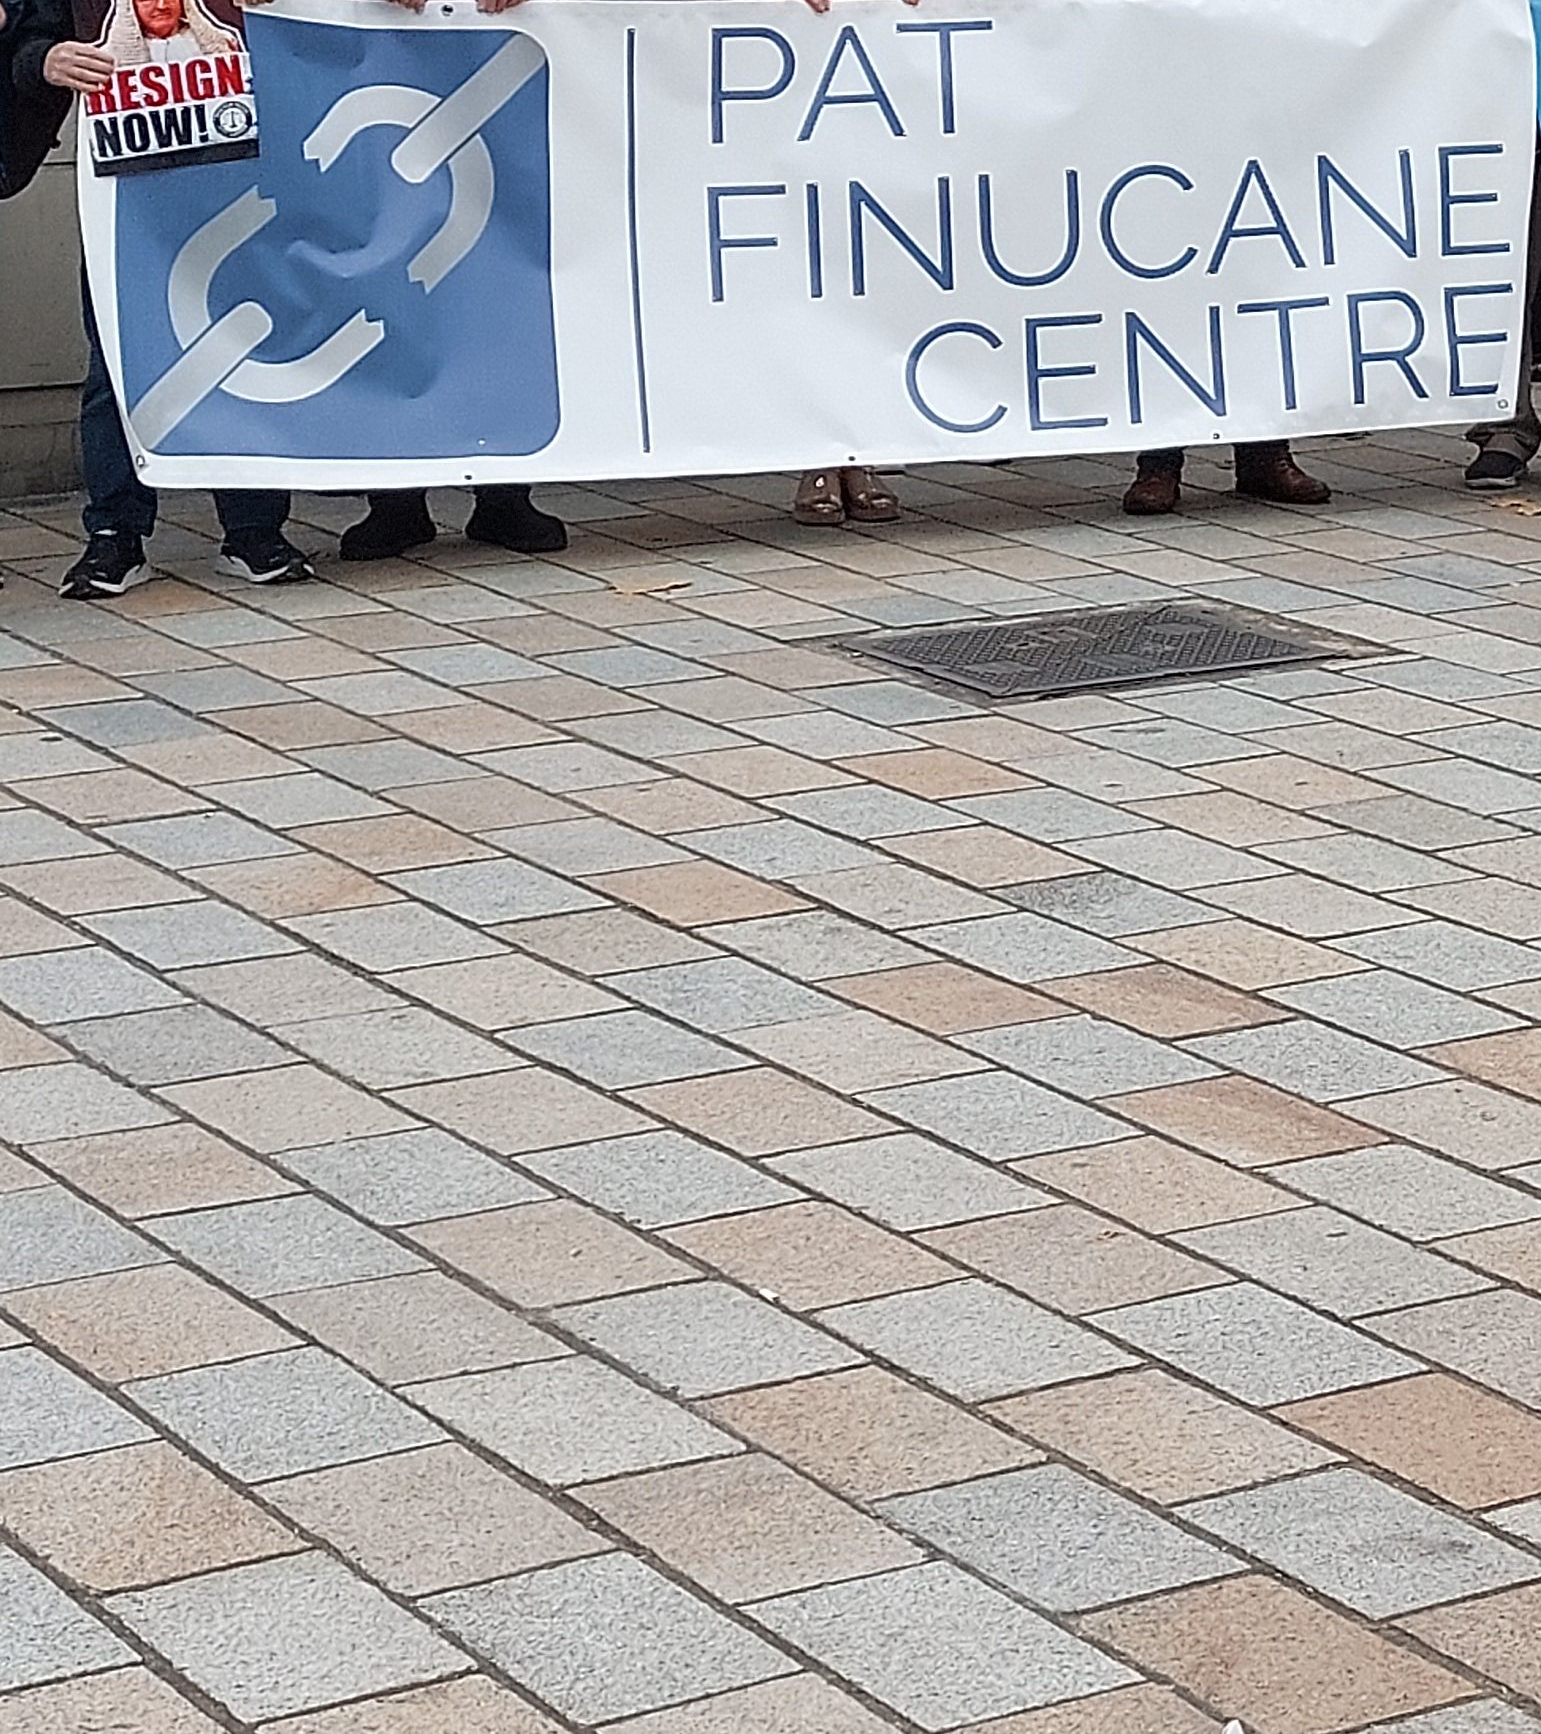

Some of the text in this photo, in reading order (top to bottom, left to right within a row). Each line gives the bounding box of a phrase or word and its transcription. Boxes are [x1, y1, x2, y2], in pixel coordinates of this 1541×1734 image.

[85, 54, 245, 116] RESIGN
[93, 103, 210, 158] NOW!
[711, 19, 992, 145] PAT
[707, 143, 1511, 303] FINUCANE
[904, 282, 1513, 434] CENTRE
